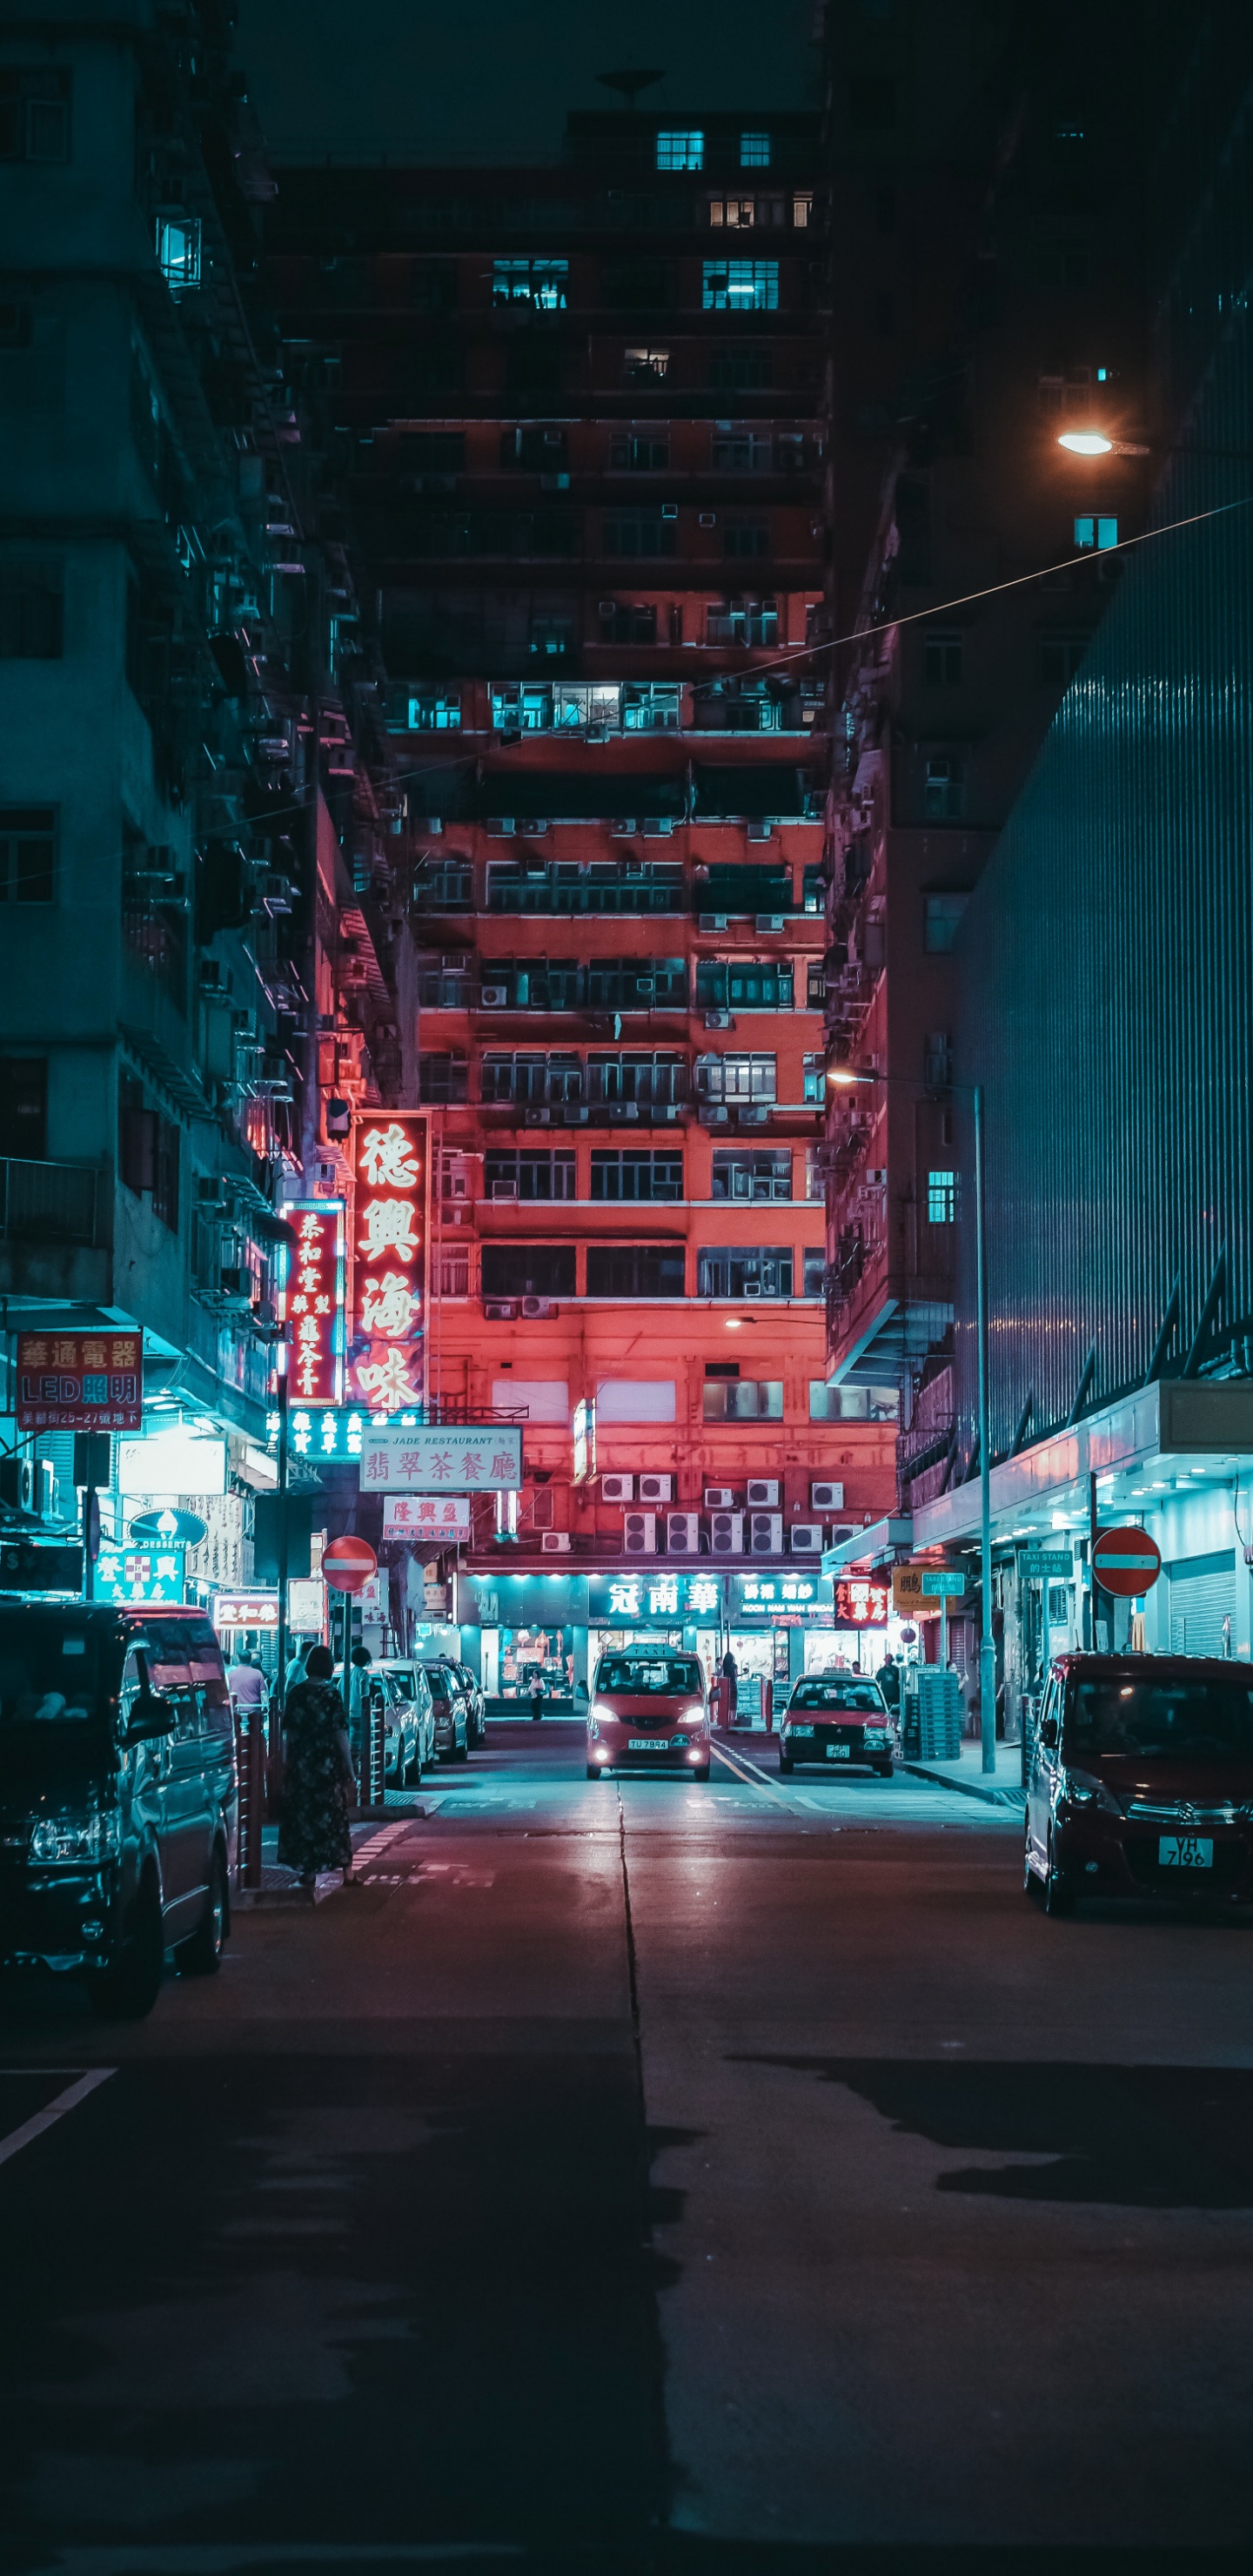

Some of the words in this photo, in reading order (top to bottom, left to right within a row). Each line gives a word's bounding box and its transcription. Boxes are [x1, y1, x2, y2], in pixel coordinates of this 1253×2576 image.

[358, 1124, 420, 1412] 德興海味
[23, 1339, 137, 1369] 華通電器
[22, 1373, 137, 1404] LED照明
[392, 1437, 420, 1446] JADE
[425, 1437, 493, 1446] RESTAURANT
[365, 1451, 518, 1481] 翡翠茶餐廳
[143, 1540, 191, 1550] DESSERTS
[900, 1573, 921, 1593] 鵬
[1029, 1563, 1062, 1573] 的士站
[609, 1583, 719, 1614] 冠南華
